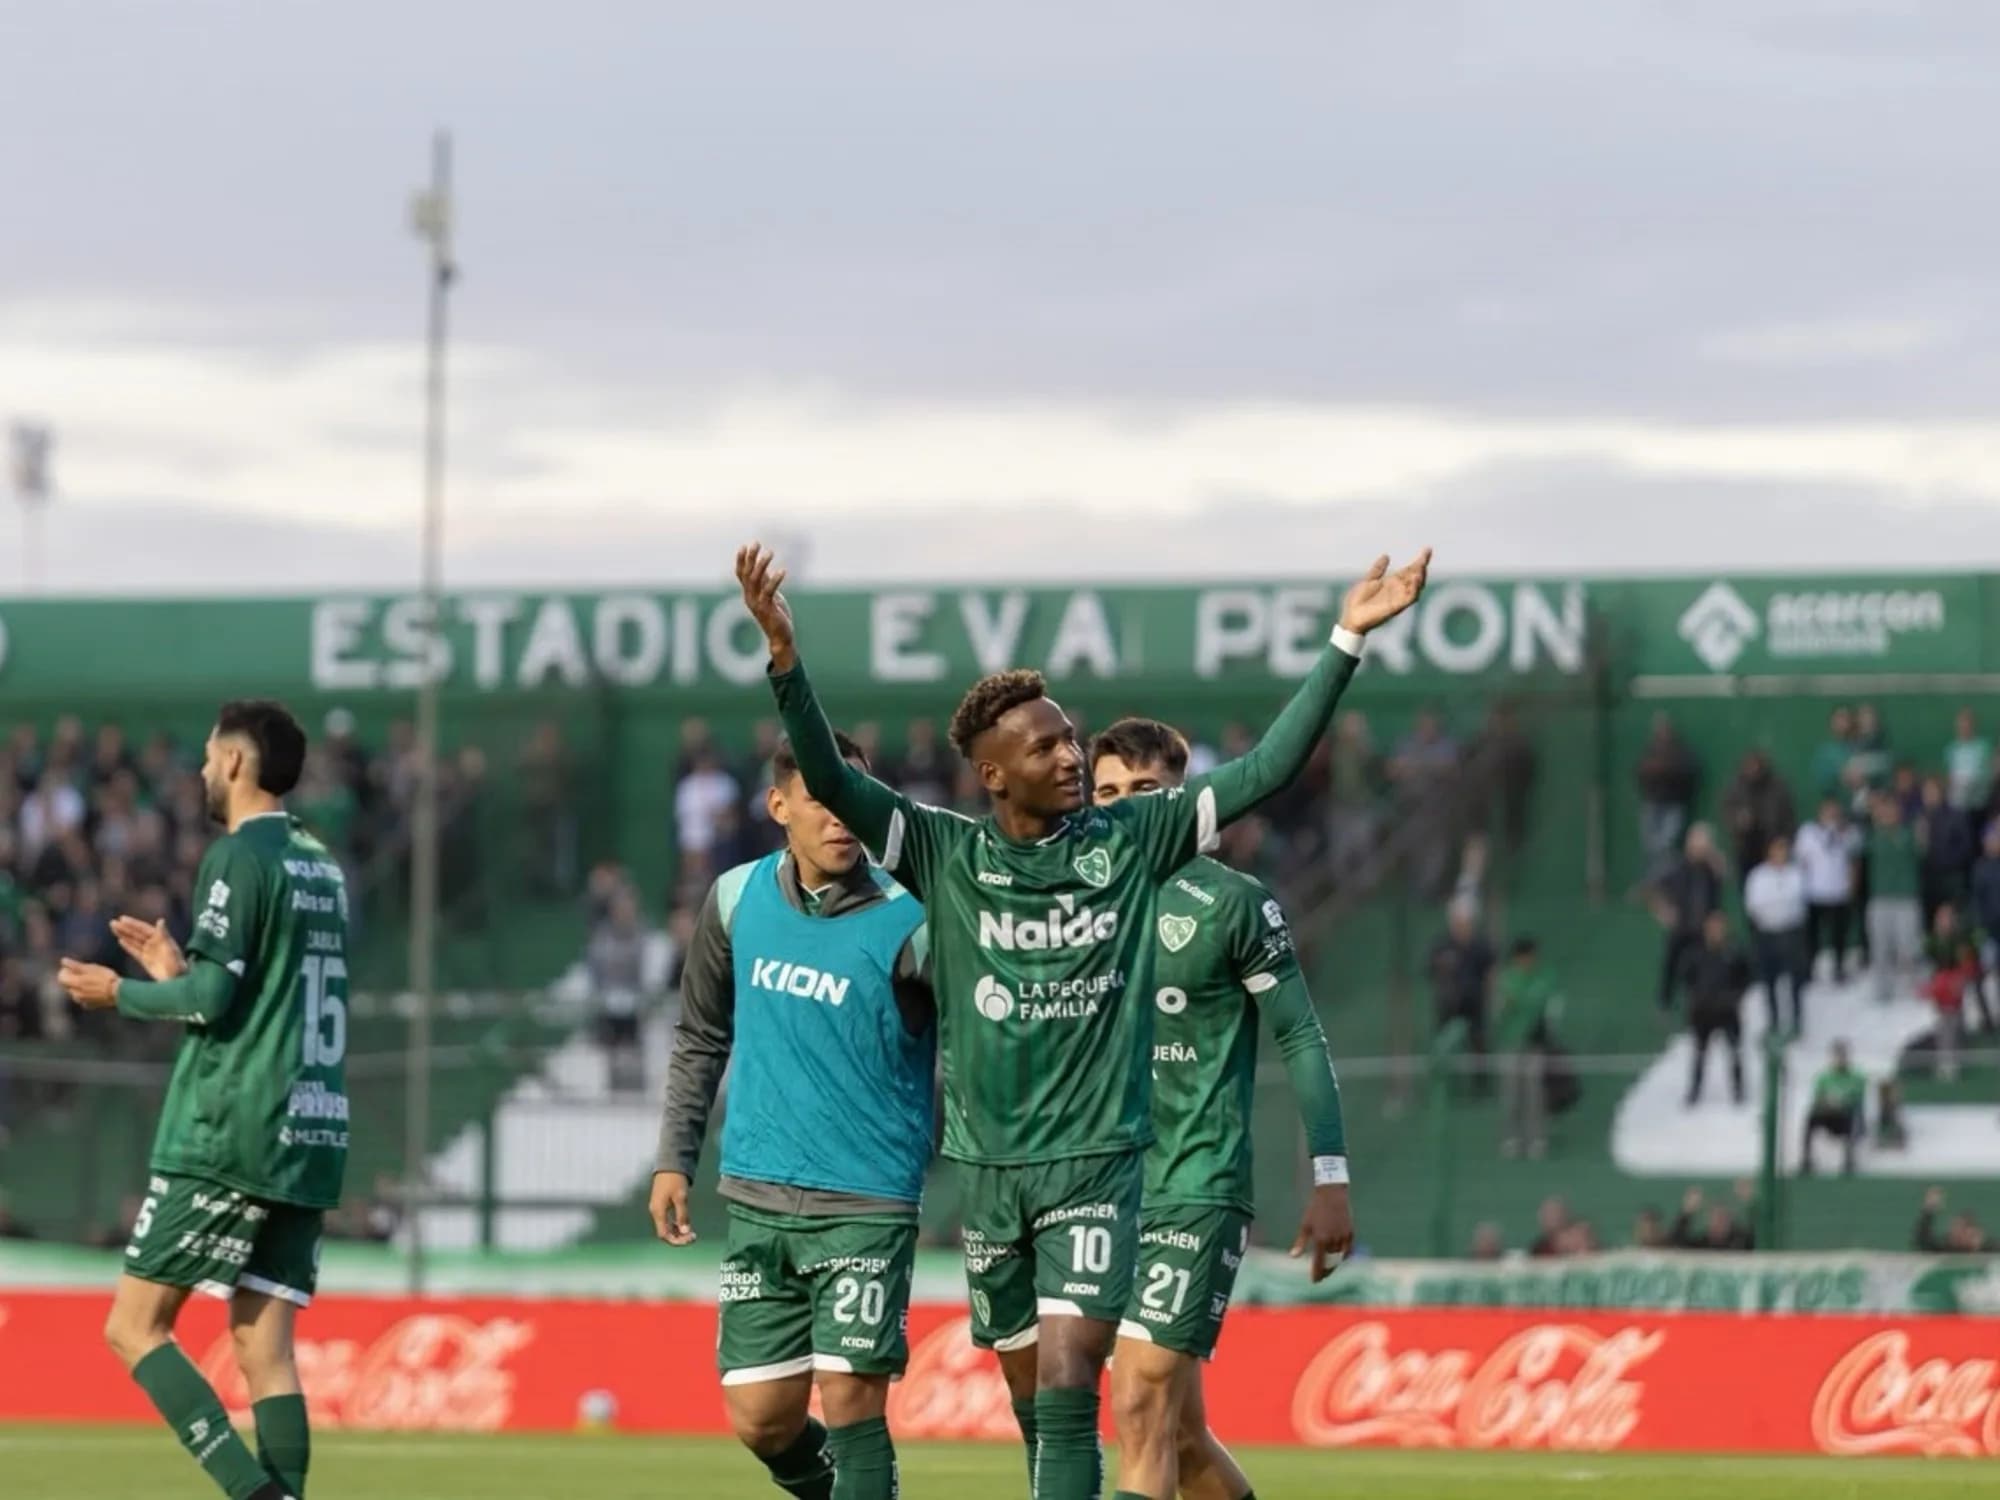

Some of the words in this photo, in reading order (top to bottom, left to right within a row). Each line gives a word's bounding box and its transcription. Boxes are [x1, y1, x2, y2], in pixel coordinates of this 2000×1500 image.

[310, 596, 769, 690] ESTADIO
[869, 590, 1120, 682] EVA
[977, 871, 1014, 886] KION
[979, 893, 1118, 951] Naldo
[751, 957, 851, 1007] KION
[1018, 982, 1045, 998] LA
[301, 954, 348, 1066] 15
[1020, 999, 1098, 1019] FAMILIA
[133, 1197, 158, 1238] 5
[1068, 1225, 1112, 1273] 10
[833, 1277, 885, 1325] 20
[1062, 1281, 1100, 1296] KION
[1141, 1262, 1191, 1315] 21
[1139, 1308, 1173, 1324] KION
[841, 1336, 875, 1349] KION
